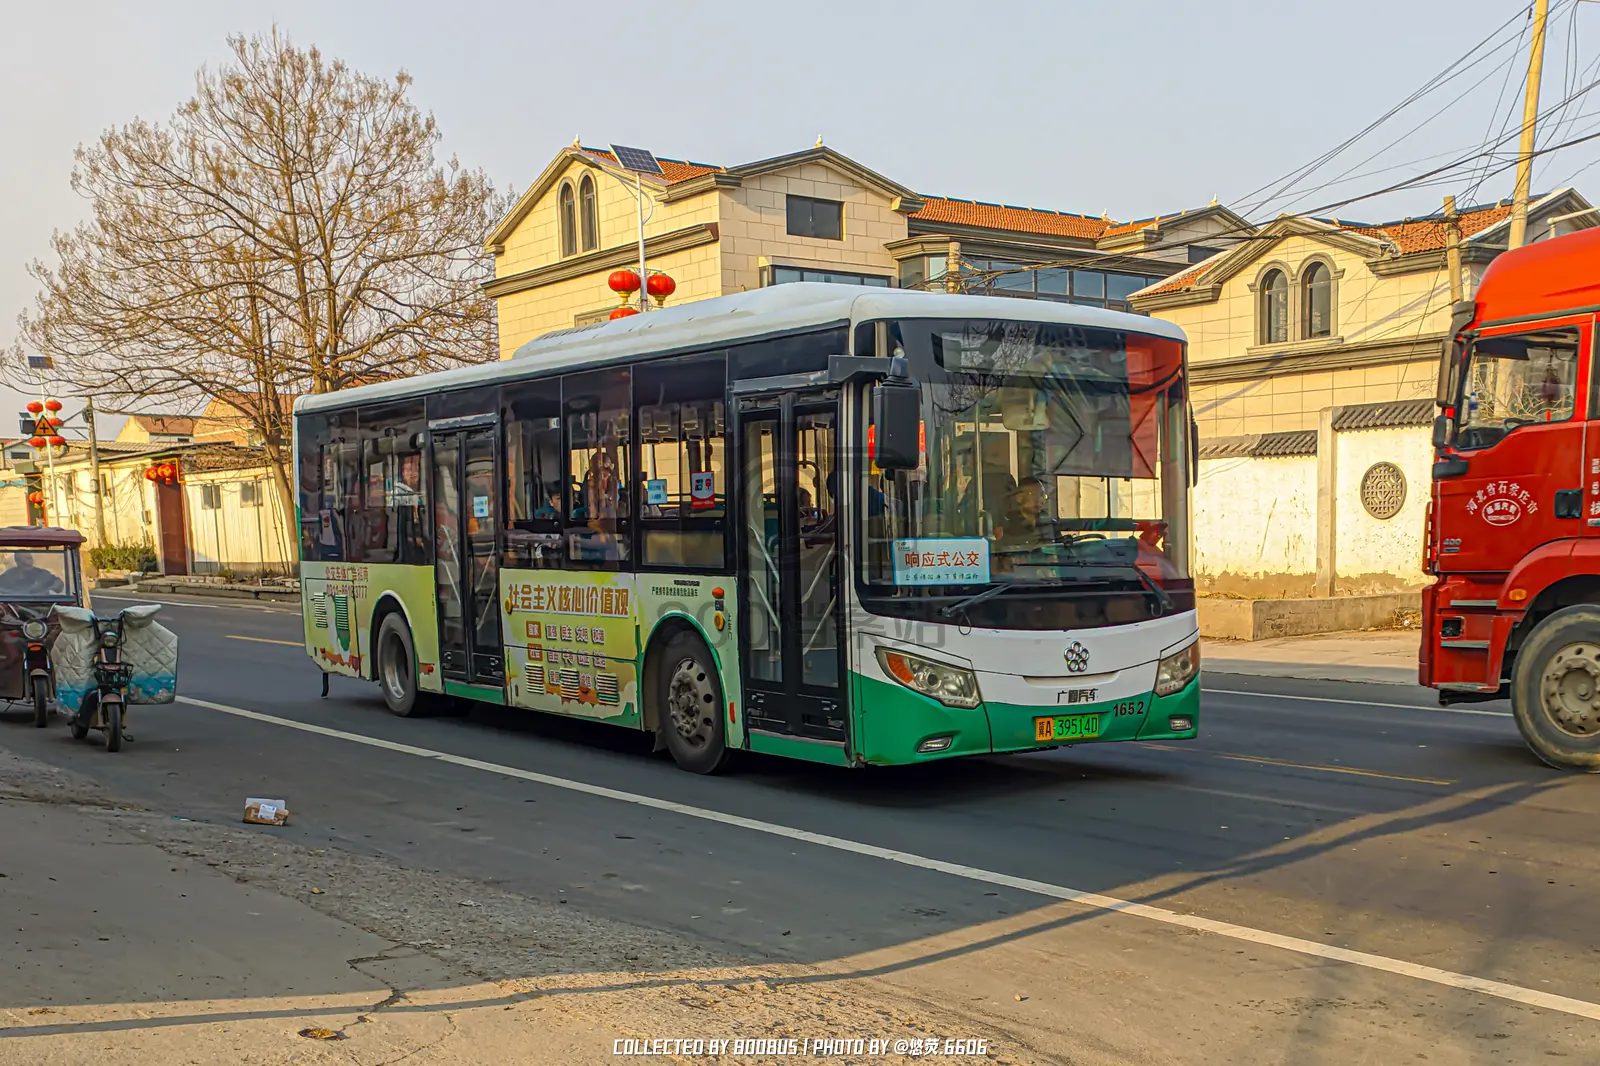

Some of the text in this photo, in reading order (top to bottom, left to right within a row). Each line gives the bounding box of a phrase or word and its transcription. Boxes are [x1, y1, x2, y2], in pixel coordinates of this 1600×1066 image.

[1466, 480, 1538, 515] 河北省石家庄市
[904, 551, 980, 568] 响应式公交
[508, 583, 629, 616] 社会主义核心价值观
[1113, 701, 1144, 717] 1652
